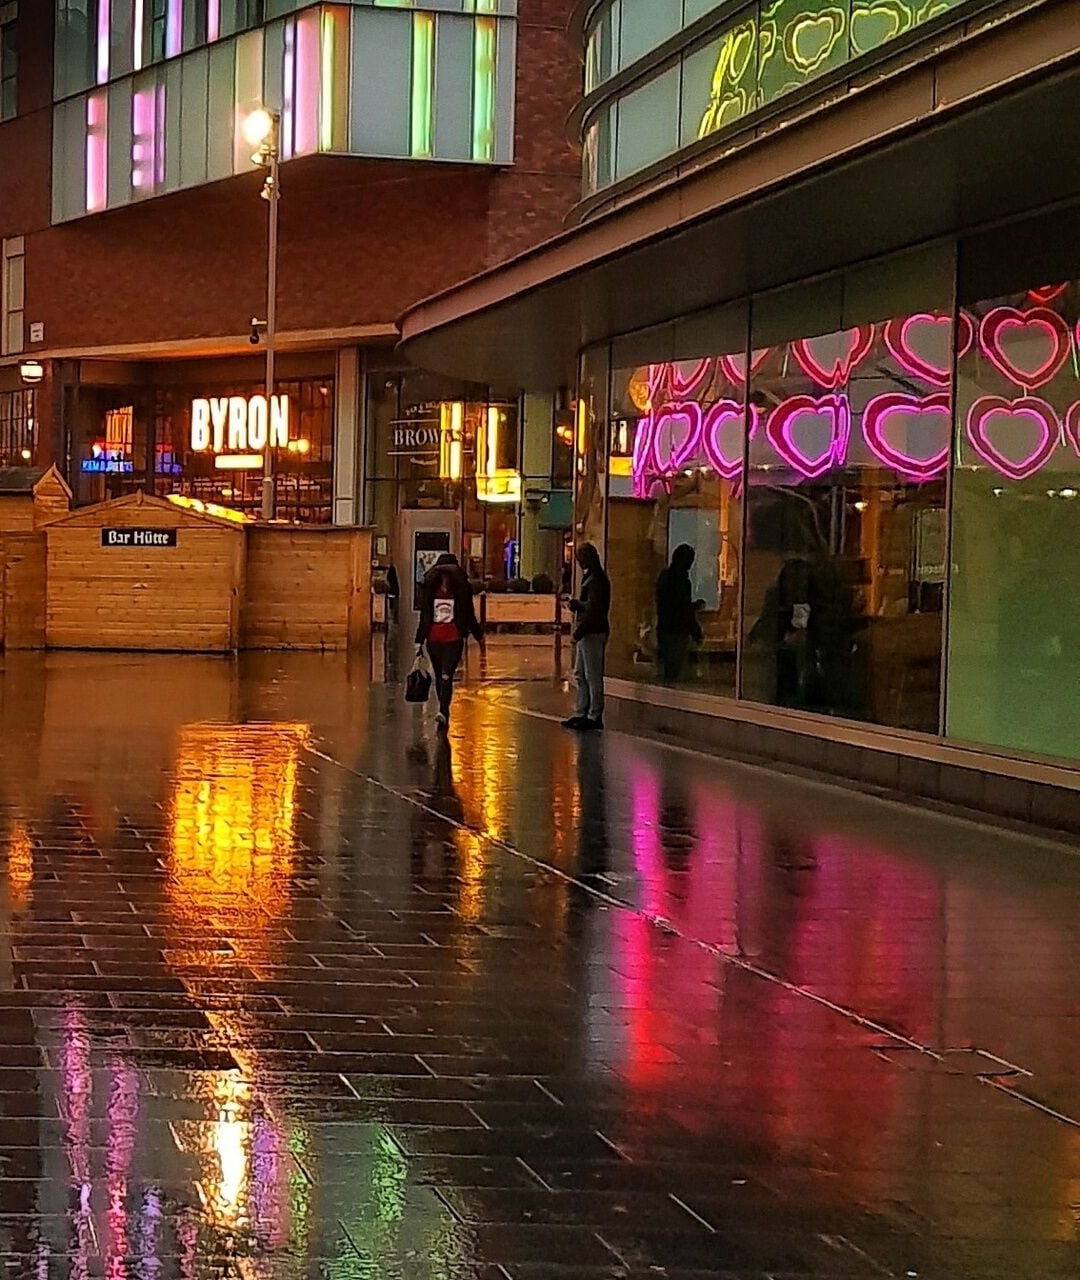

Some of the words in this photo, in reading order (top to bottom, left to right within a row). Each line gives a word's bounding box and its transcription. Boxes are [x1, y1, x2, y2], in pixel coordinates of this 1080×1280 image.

[191, 395, 289, 452] BYRON
[108, 530, 130, 545] Bar
[133, 529, 170, 545] Hütte
